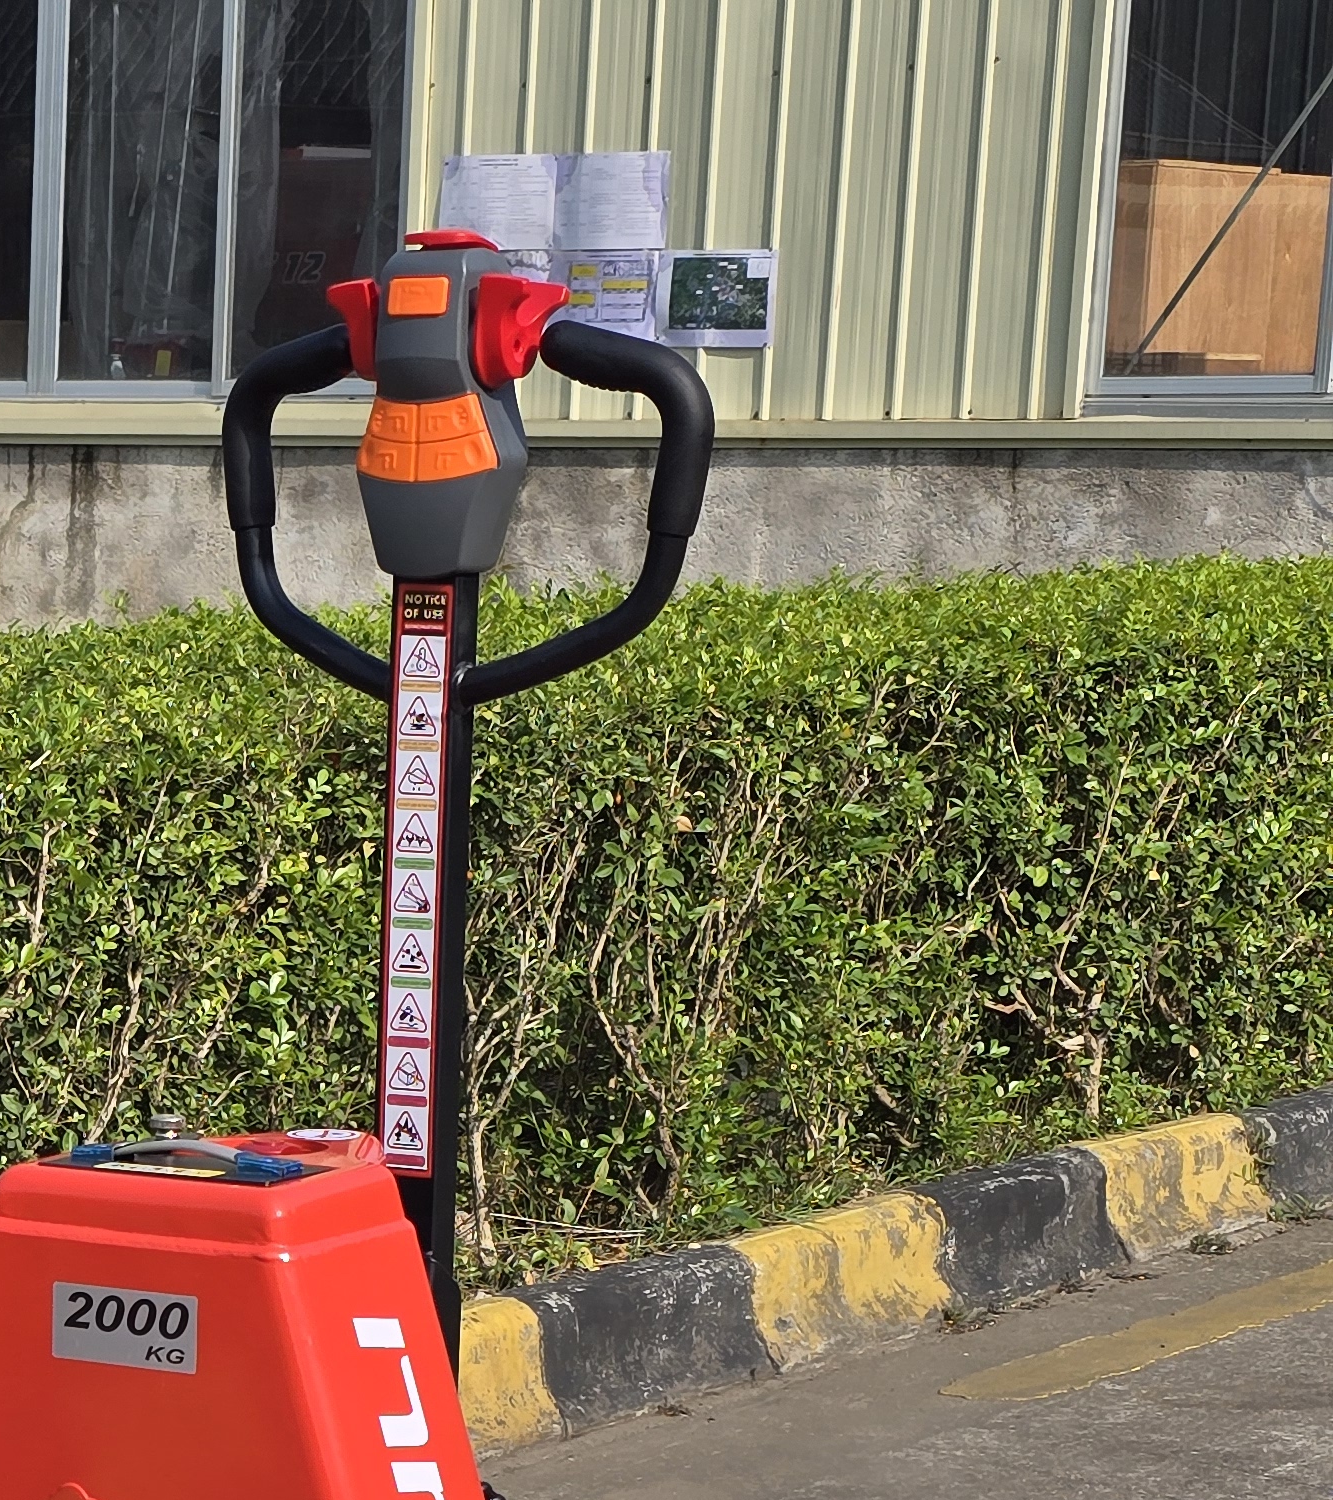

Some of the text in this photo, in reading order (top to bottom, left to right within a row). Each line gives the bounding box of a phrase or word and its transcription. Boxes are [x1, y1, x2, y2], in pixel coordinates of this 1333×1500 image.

[282, 250, 327, 285] 12
[404, 593, 447, 606] NOTICE
[404, 608, 419, 619] OF
[64, 1291, 190, 1340] 2000
[145, 1345, 186, 1365] KG
